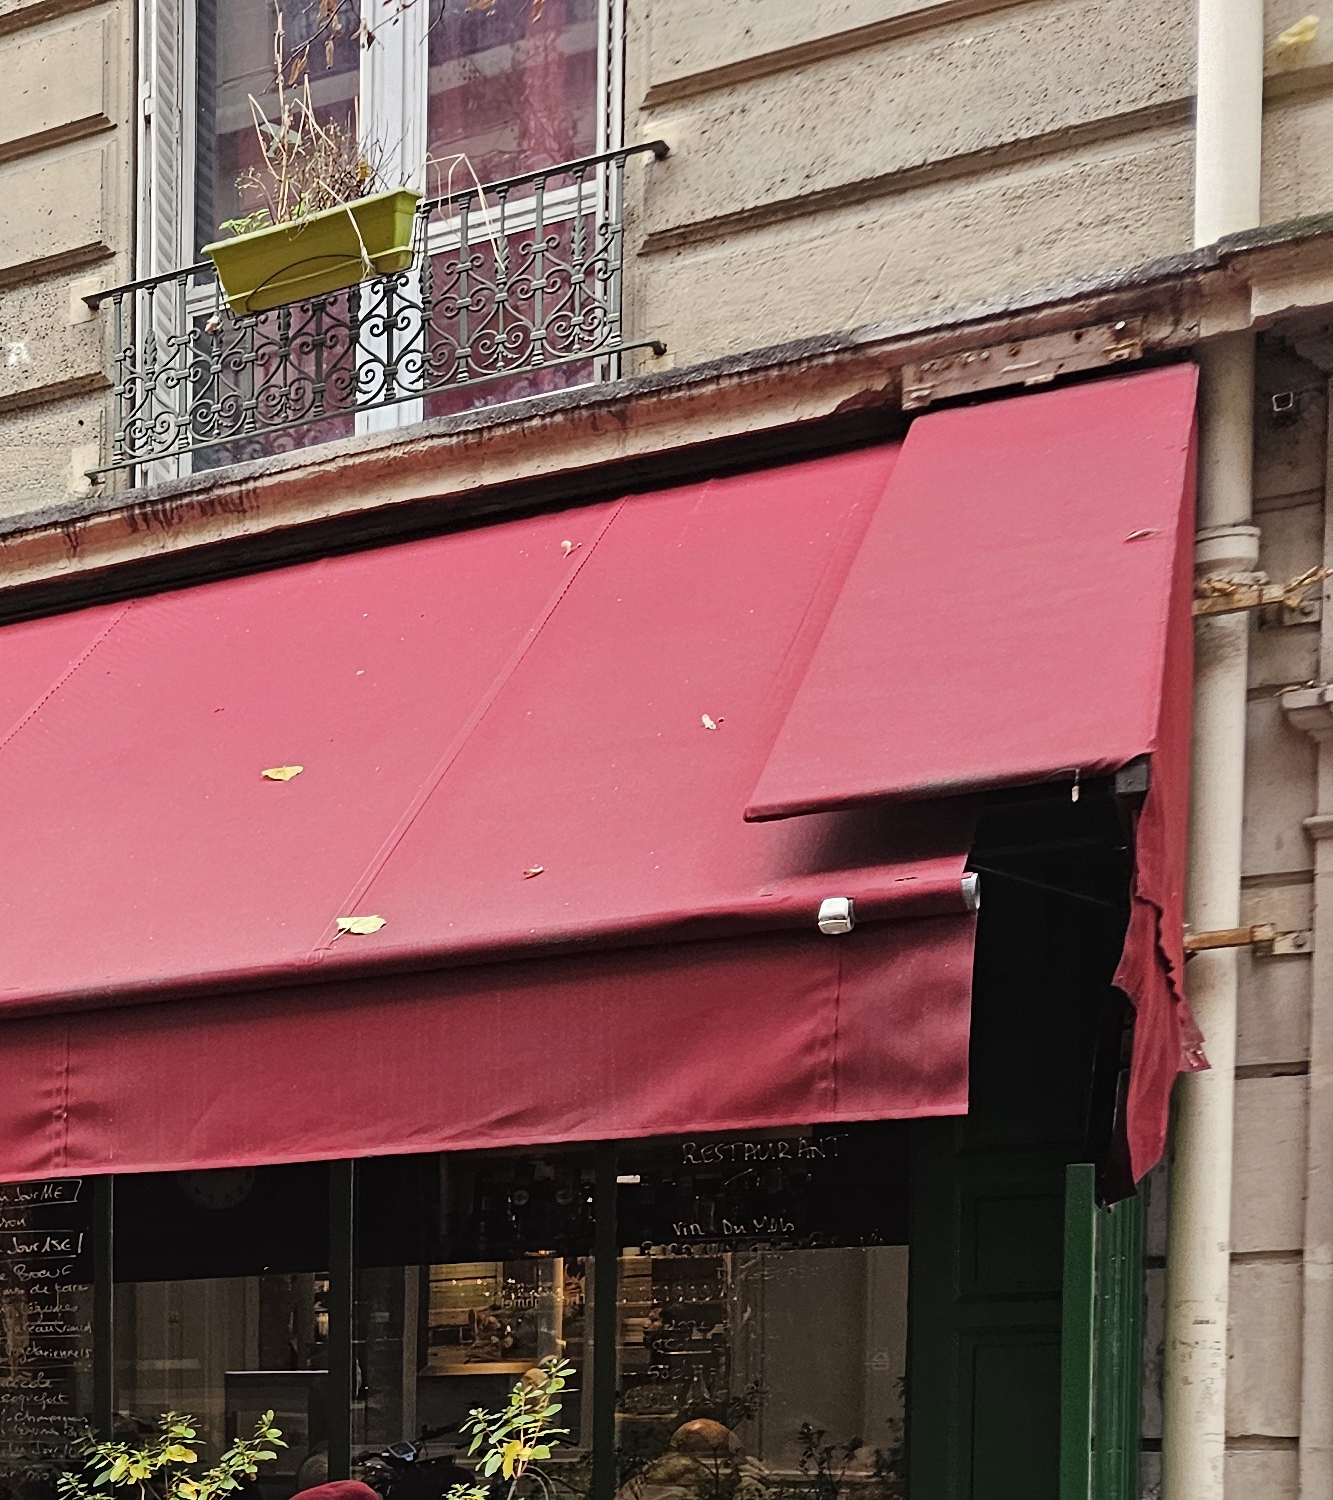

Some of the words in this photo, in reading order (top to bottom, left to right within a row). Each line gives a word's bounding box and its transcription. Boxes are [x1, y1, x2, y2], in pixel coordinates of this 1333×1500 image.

[682, 1133, 849, 1165] RESTAURANT
[673, 1221, 706, 1236] Vin
[6, 1236, 40, 1255] Jour
